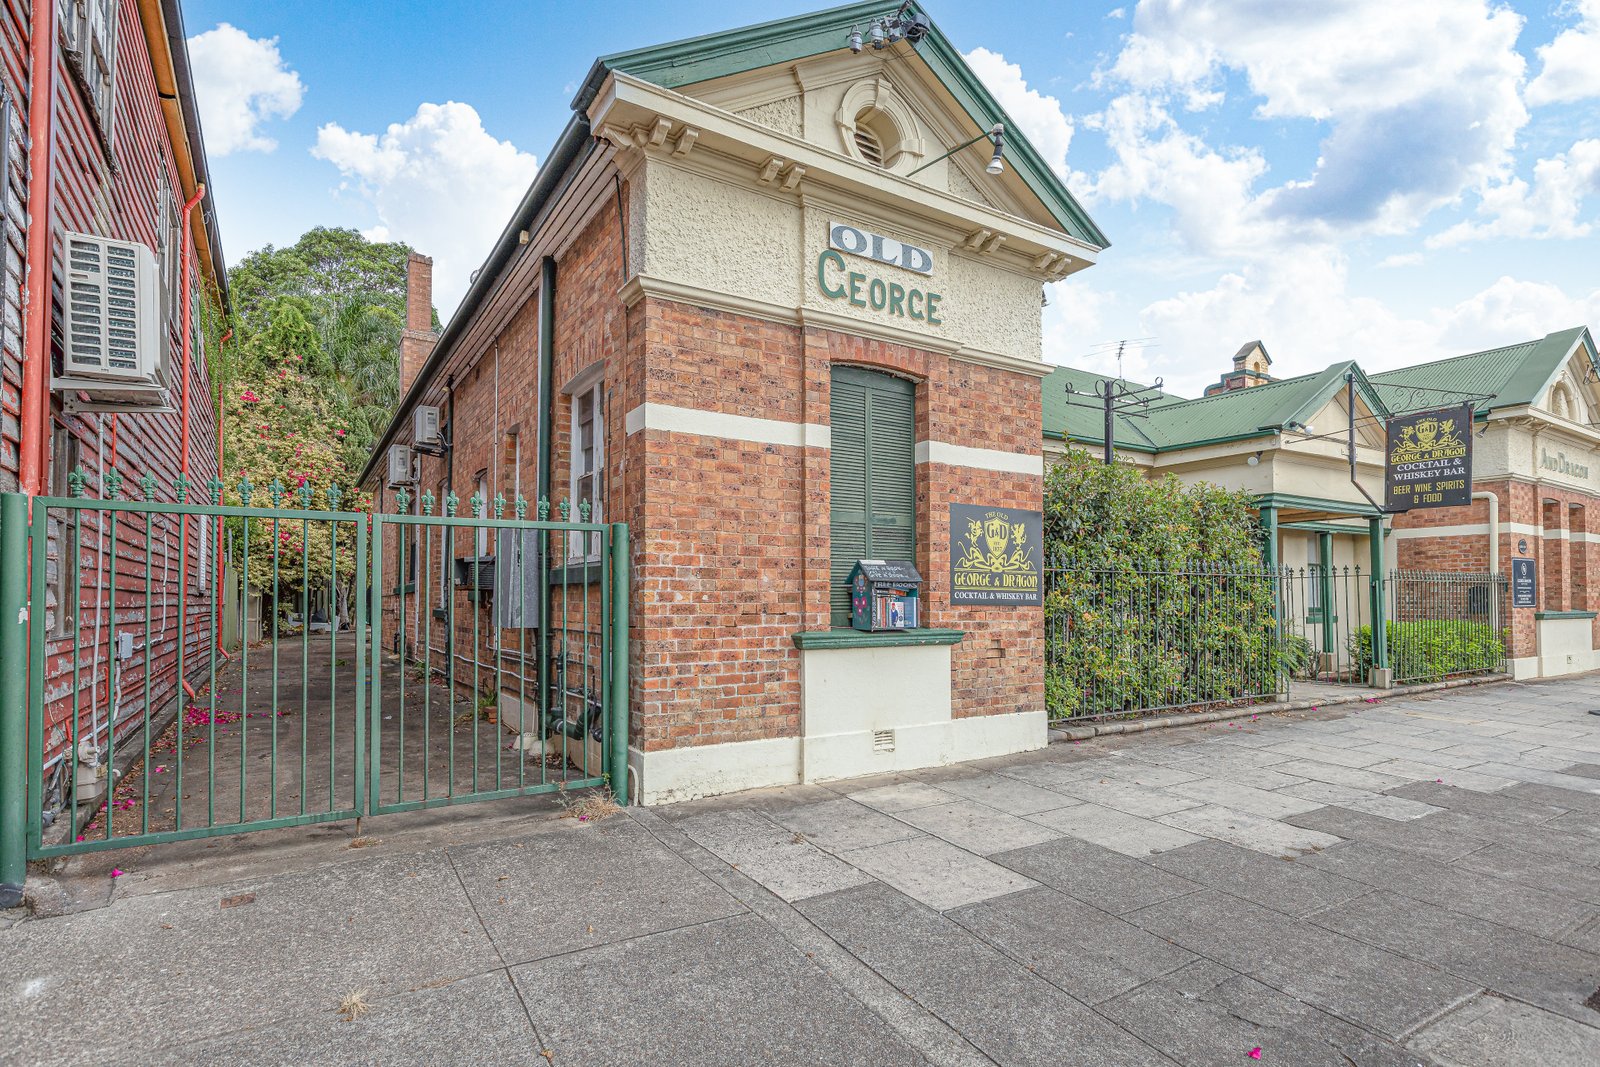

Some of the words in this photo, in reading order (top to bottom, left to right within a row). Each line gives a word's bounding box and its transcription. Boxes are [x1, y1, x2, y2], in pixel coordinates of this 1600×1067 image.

[831, 225, 932, 273] OLD
[818, 250, 942, 325] GEORGE
[1391, 452, 1422, 463] GEORGE
[1432, 447, 1466, 458] DRAGON
[1396, 459, 1451, 472] COCKTAIL
[1393, 469, 1443, 480] WHISKEY
[1443, 467, 1466, 476] BAR
[1393, 484, 1411, 495] BEER
[1414, 483, 1432, 493] WINE
[1436, 480, 1465, 491] SPIRITS
[1413, 495, 1419, 504] &
[1423, 493, 1443, 503] FOOD
[985, 511, 996, 519] THE
[996, 511, 1009, 520] OLD
[954, 572, 992, 586] GEORGE
[994, 577, 1000, 587] &
[1003, 573, 1038, 588] DRAGON
[954, 591, 989, 599] COCKTAIL
[995, 592, 1024, 600] WHISKEY
